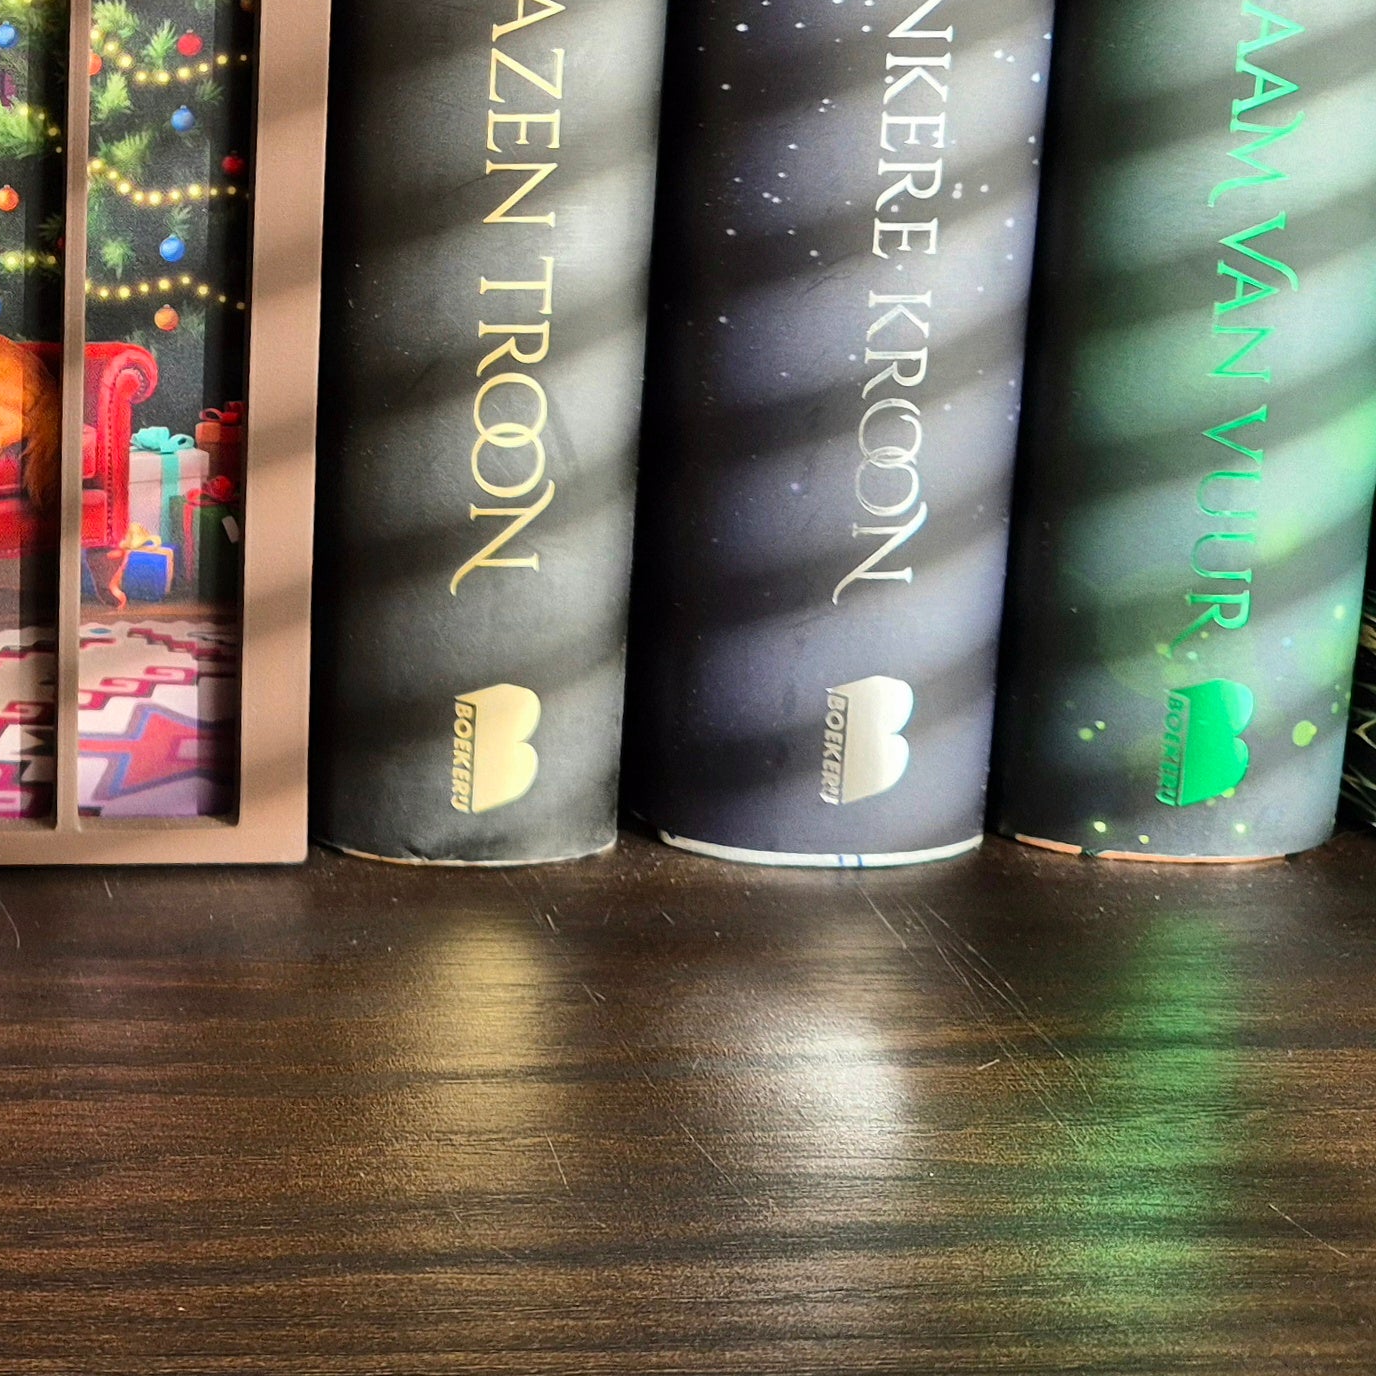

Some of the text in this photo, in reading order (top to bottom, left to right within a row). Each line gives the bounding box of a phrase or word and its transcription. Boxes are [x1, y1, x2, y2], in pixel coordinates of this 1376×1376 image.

[450, 256, 556, 596] TROON
[1207, 210, 1300, 383] VAN
[831, 289, 933, 606] KROON
[1167, 403, 1270, 658] VUUR
